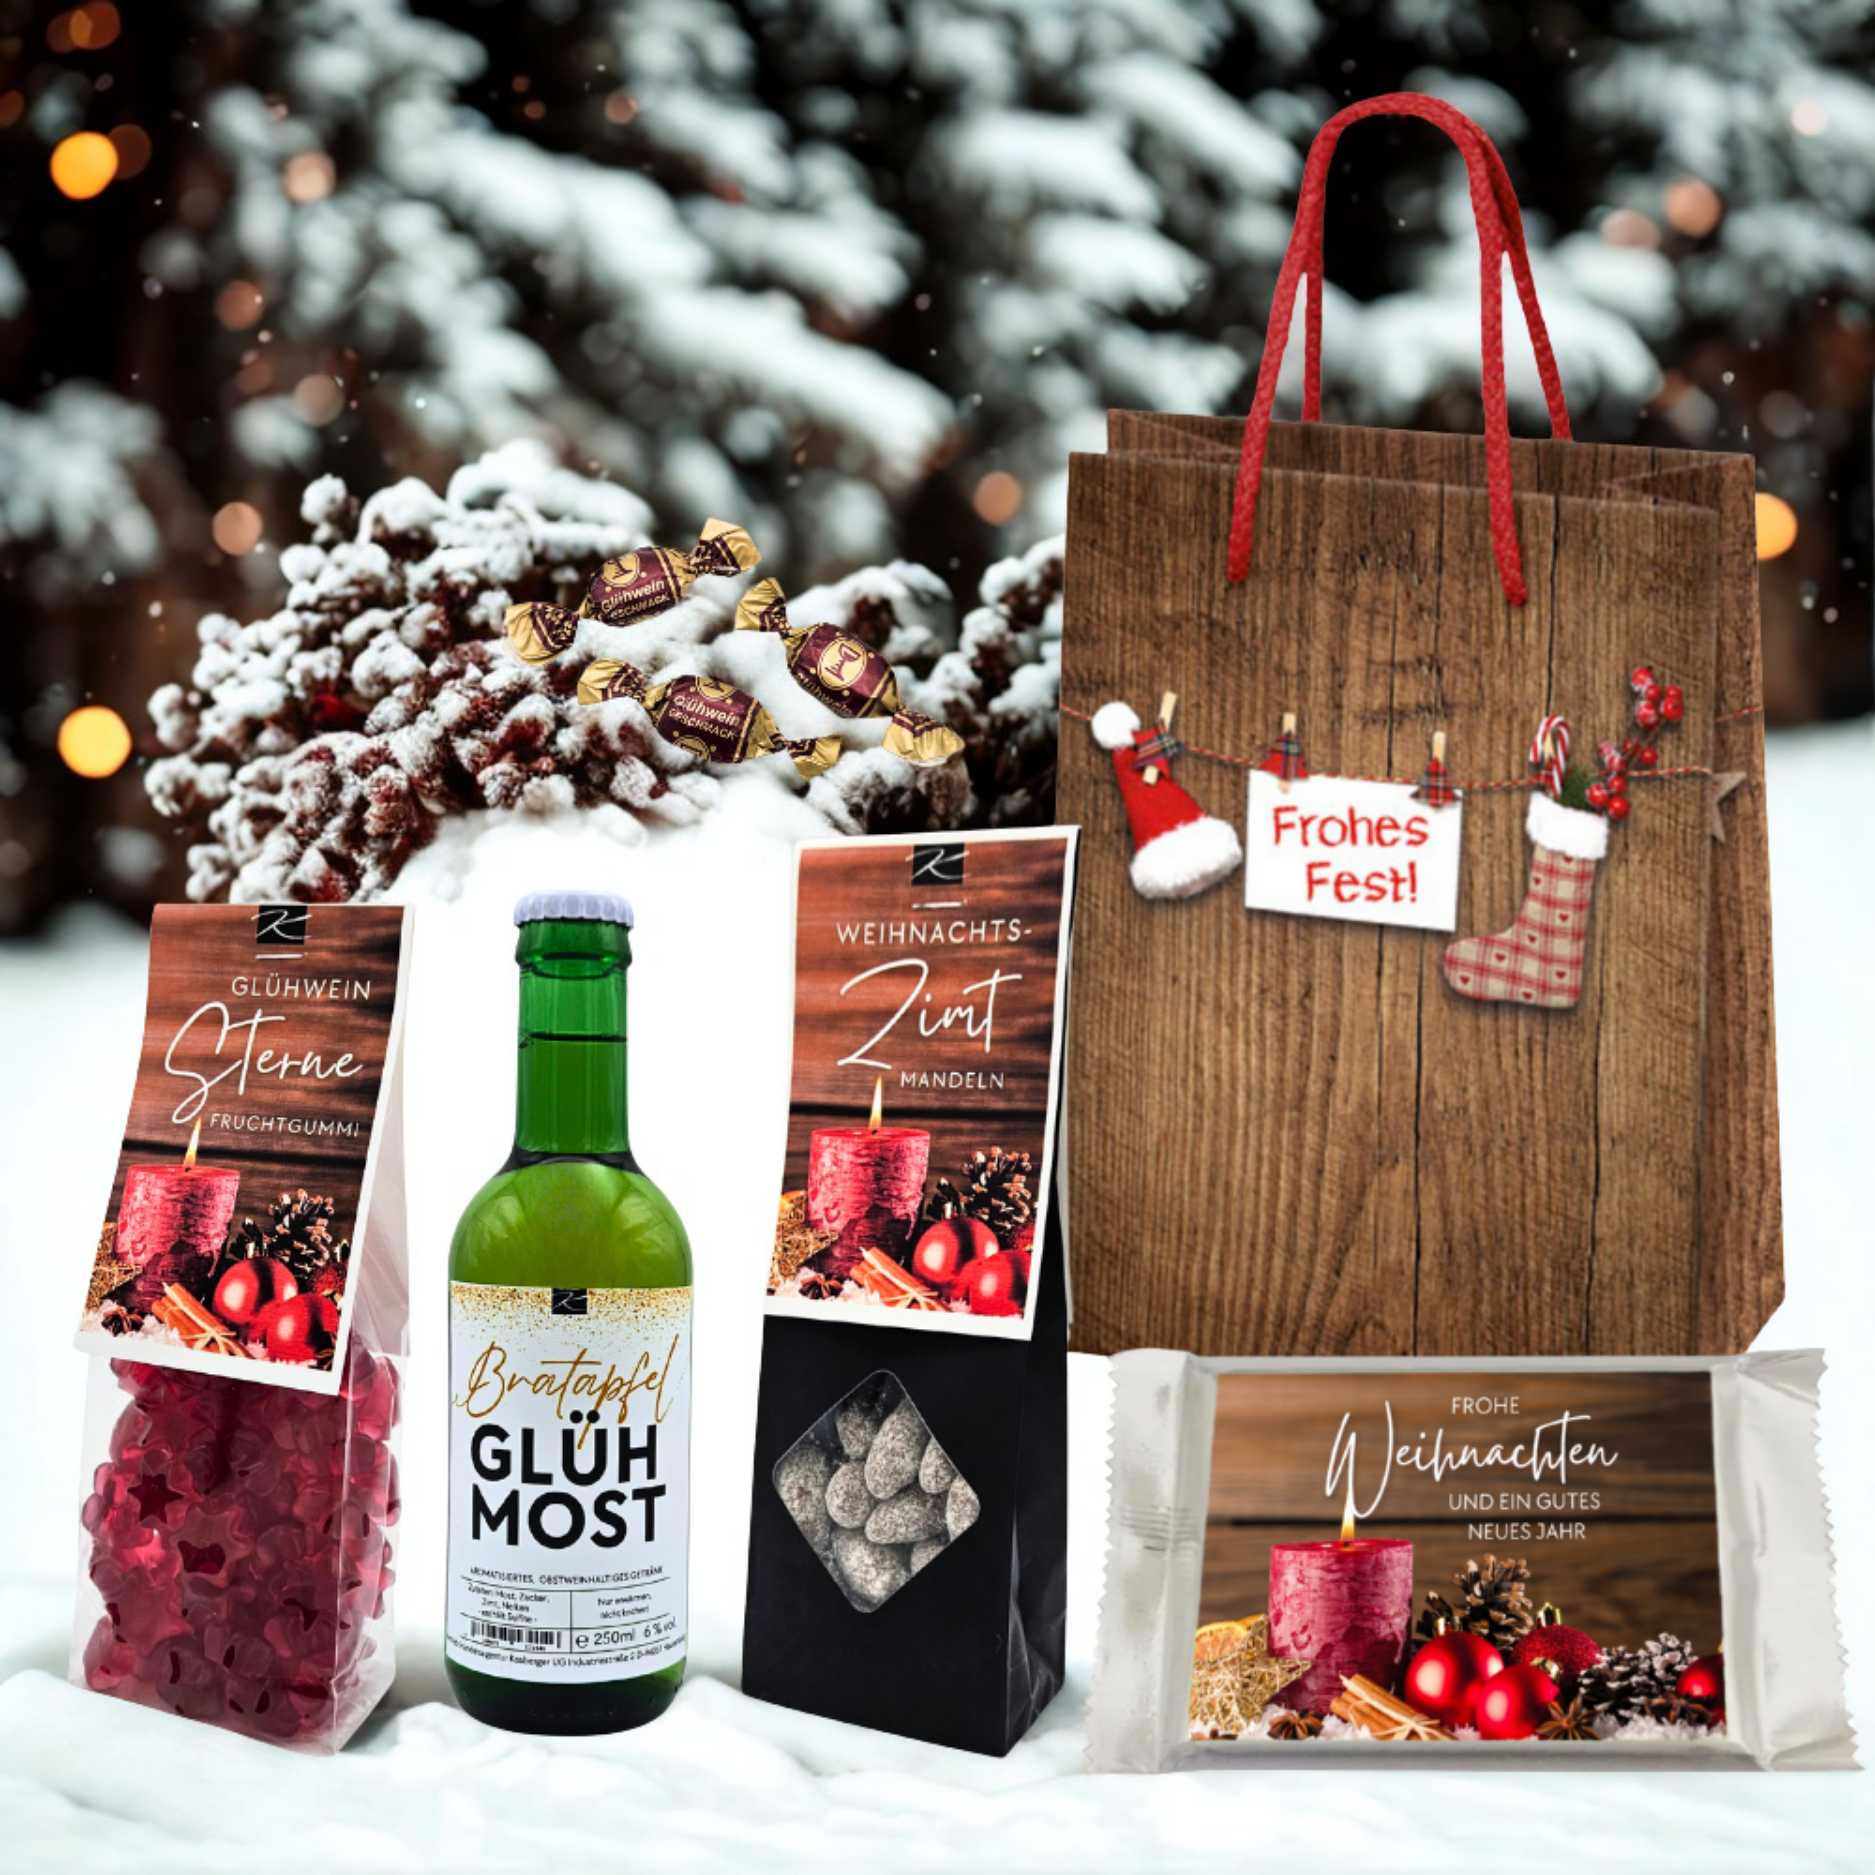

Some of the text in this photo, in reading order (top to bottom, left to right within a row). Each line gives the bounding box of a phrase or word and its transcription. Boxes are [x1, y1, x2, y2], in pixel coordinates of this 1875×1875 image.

[601, 580, 665, 613] Glühwein
[668, 708, 736, 741] GESCHMACK
[673, 694, 741, 726] Glühwein
[1273, 805, 1430, 847] Frohes
[1306, 861, 1417, 904] Fest!
[835, 918, 1032, 945] WEIHNACHTS-
[231, 972, 372, 1000] GLÜHWEIN
[836, 957, 1023, 1071] Zimt
[164, 1001, 364, 1124] Sterne
[900, 1072, 1005, 1090] MANDELN
[209, 1113, 360, 1138] FRUCHTGUMMI
[452, 1332, 680, 1450] Bratapfel
[1451, 1396, 1520, 1415] FROHE
[470, 1409, 658, 1487] GLÜH
[1325, 1400, 1619, 1519] Weihnachten
[471, 1483, 667, 1550] MOST
[1448, 1492, 1601, 1511] UND EIN GUTES
[1467, 1522, 1587, 1541] NEUES JAHR
[593, 1627, 636, 1646] 250ml
